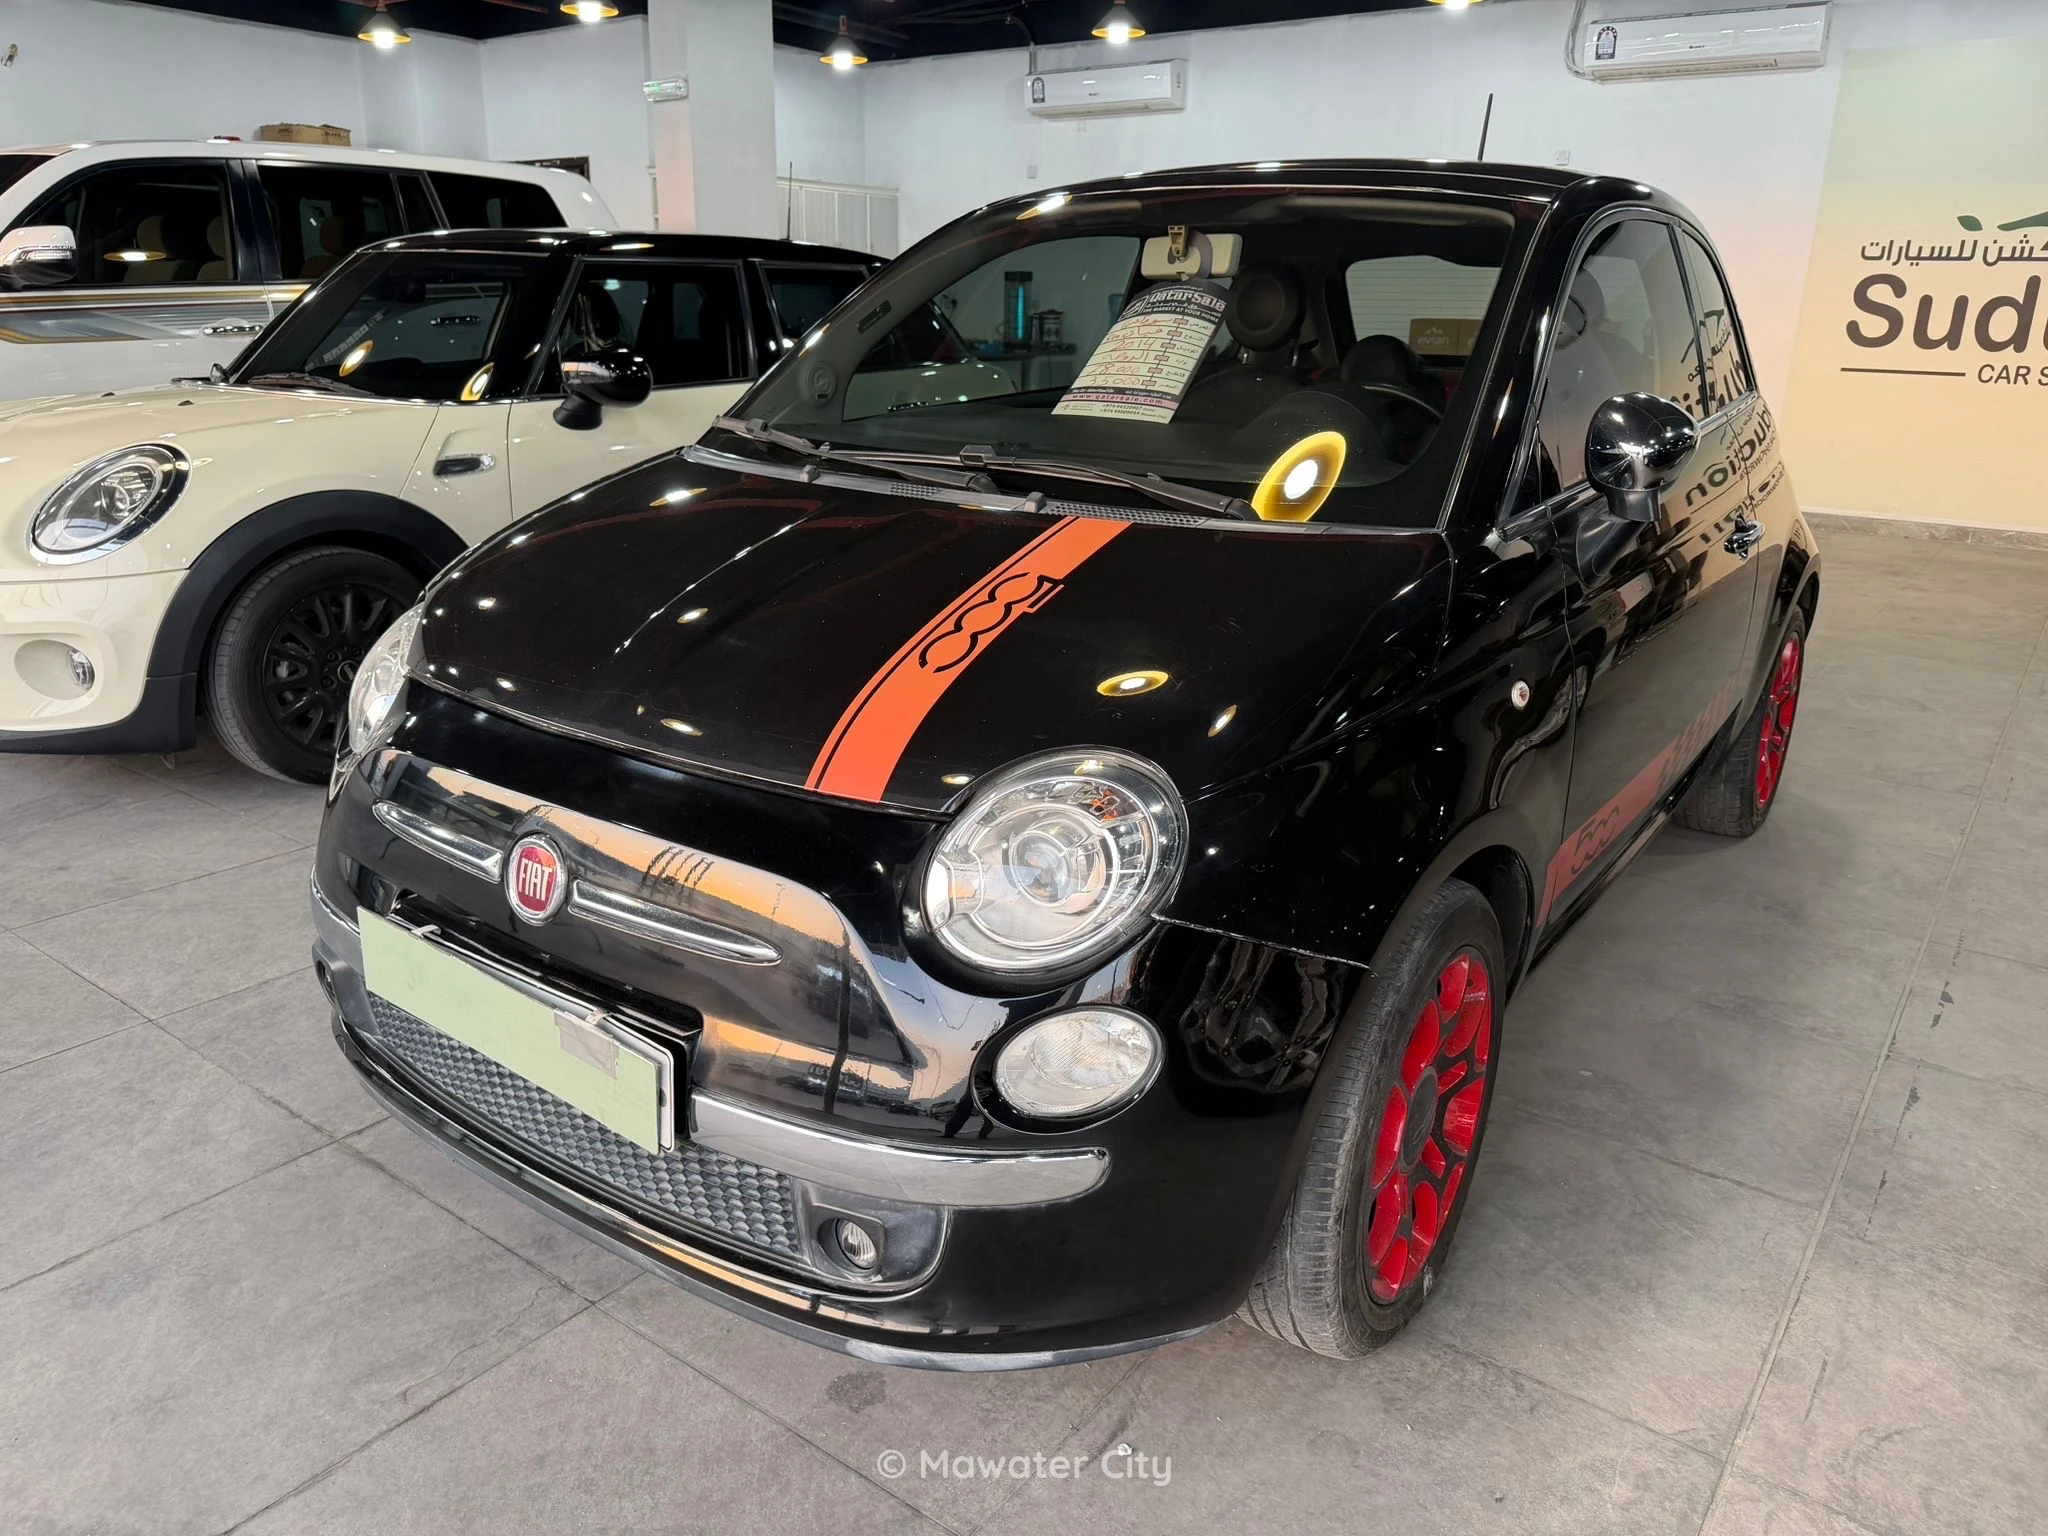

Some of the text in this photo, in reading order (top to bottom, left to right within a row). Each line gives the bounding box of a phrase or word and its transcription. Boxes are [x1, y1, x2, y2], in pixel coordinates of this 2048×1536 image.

[1860, 239, 1979, 267] للسيارات
[1846, 273, 2048, 353] Sud
[1978, 363, 2031, 385] CAR
[518, 857, 553, 902] FIAT
